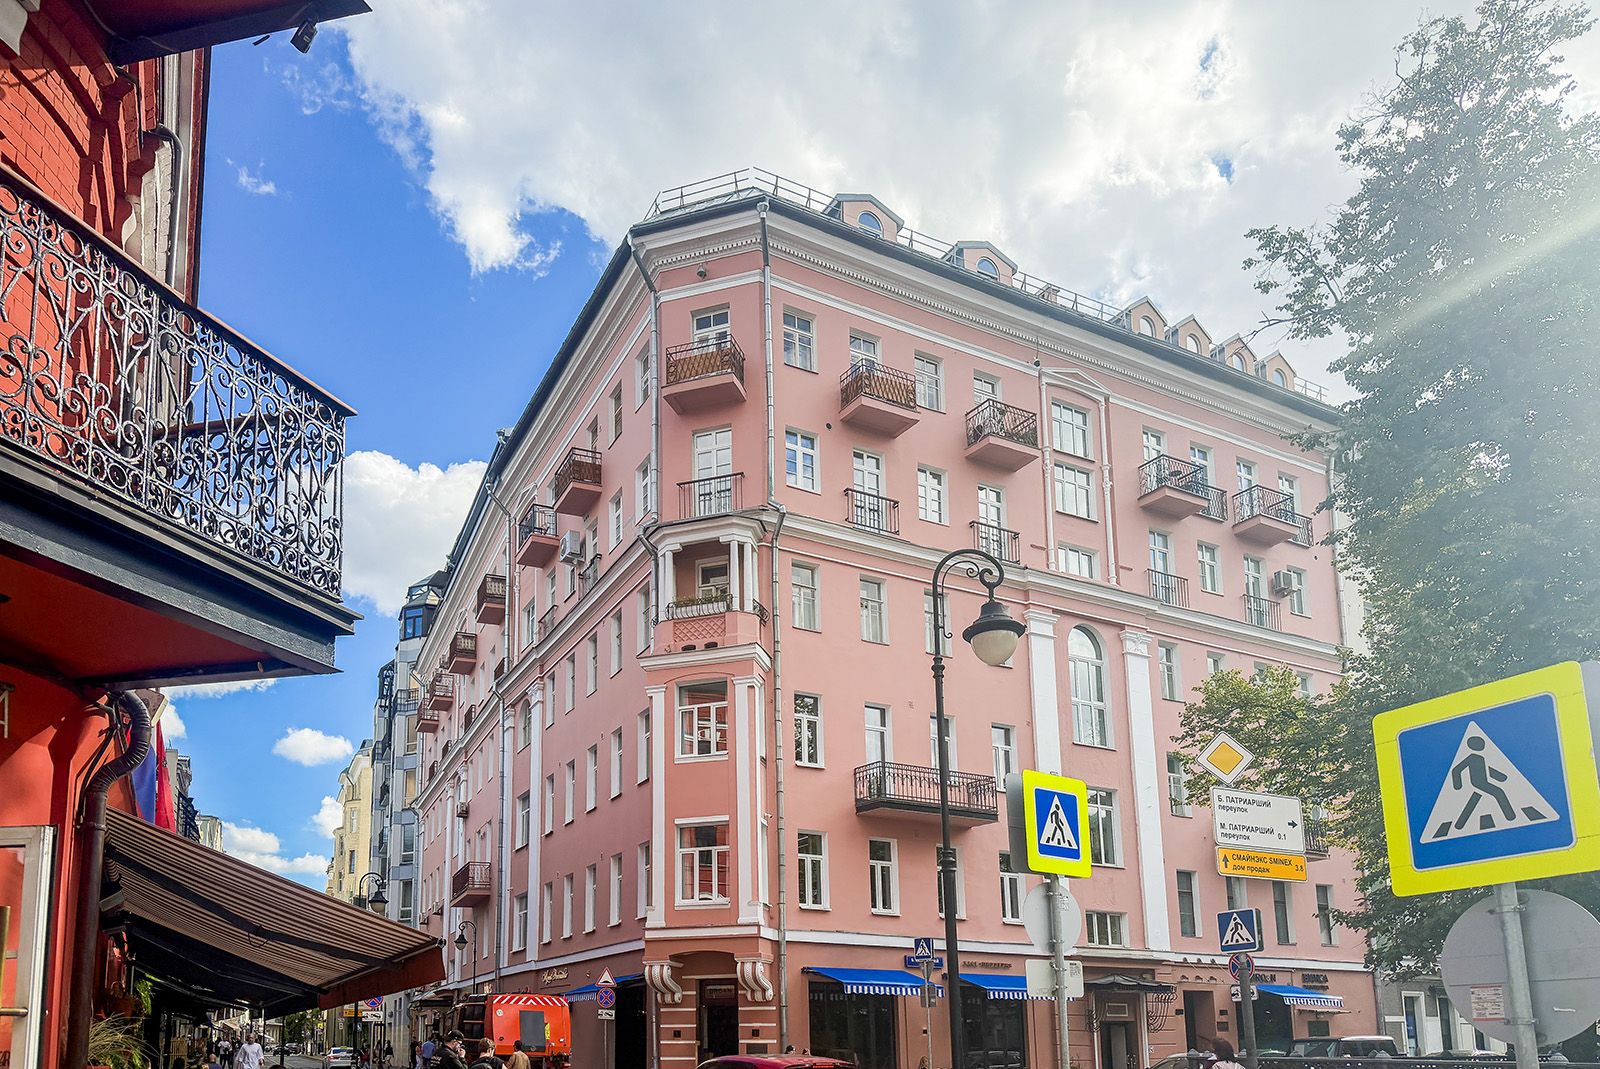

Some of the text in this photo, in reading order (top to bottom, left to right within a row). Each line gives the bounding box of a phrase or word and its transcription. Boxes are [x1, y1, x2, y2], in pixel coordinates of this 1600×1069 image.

[1226, 796, 1271, 808] ПАТРИАРШИЙ
[1218, 804, 1248, 813] переулок
[1220, 822, 1228, 830] М.
[1229, 823, 1275, 835] ПАТРИАРШИЙ
[1221, 832, 1250, 841] переулок
[1232, 854, 1268, 864] СМАЙНЭКС
[1269, 857, 1293, 866] SMINEX
